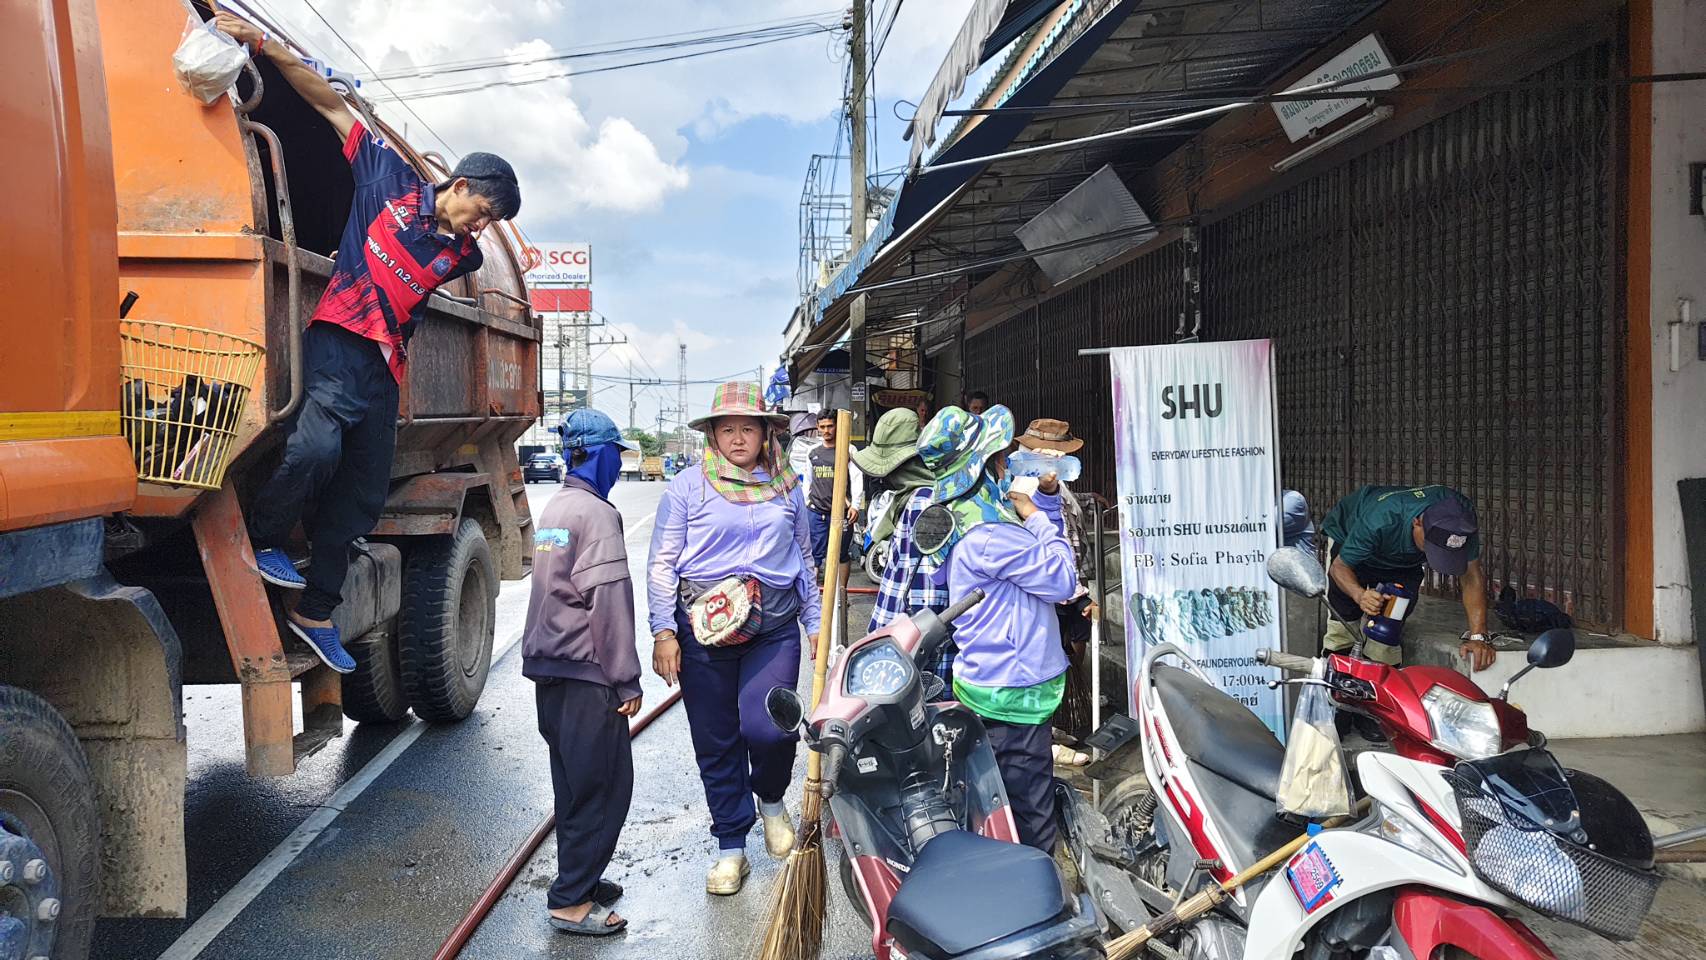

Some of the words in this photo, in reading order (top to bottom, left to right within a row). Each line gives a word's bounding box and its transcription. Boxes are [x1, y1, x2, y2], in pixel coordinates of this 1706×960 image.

[549, 250, 587, 265] SCG
[562, 272, 586, 280] Dealer
[1161, 383, 1223, 420] SHU
[1151, 450, 1190, 461] EVERYDAY
[1191, 448, 1230, 459] LIFESTYLE
[1231, 446, 1266, 457] FASHION
[1126, 487, 1171, 505] จำหน่าย
[1128, 518, 1171, 538] รองเท้า
[1173, 522, 1202, 536] SHU
[1134, 553, 1154, 568] FB
[1170, 551, 1208, 567] Sofia
[1215, 549, 1265, 566] Phayib
